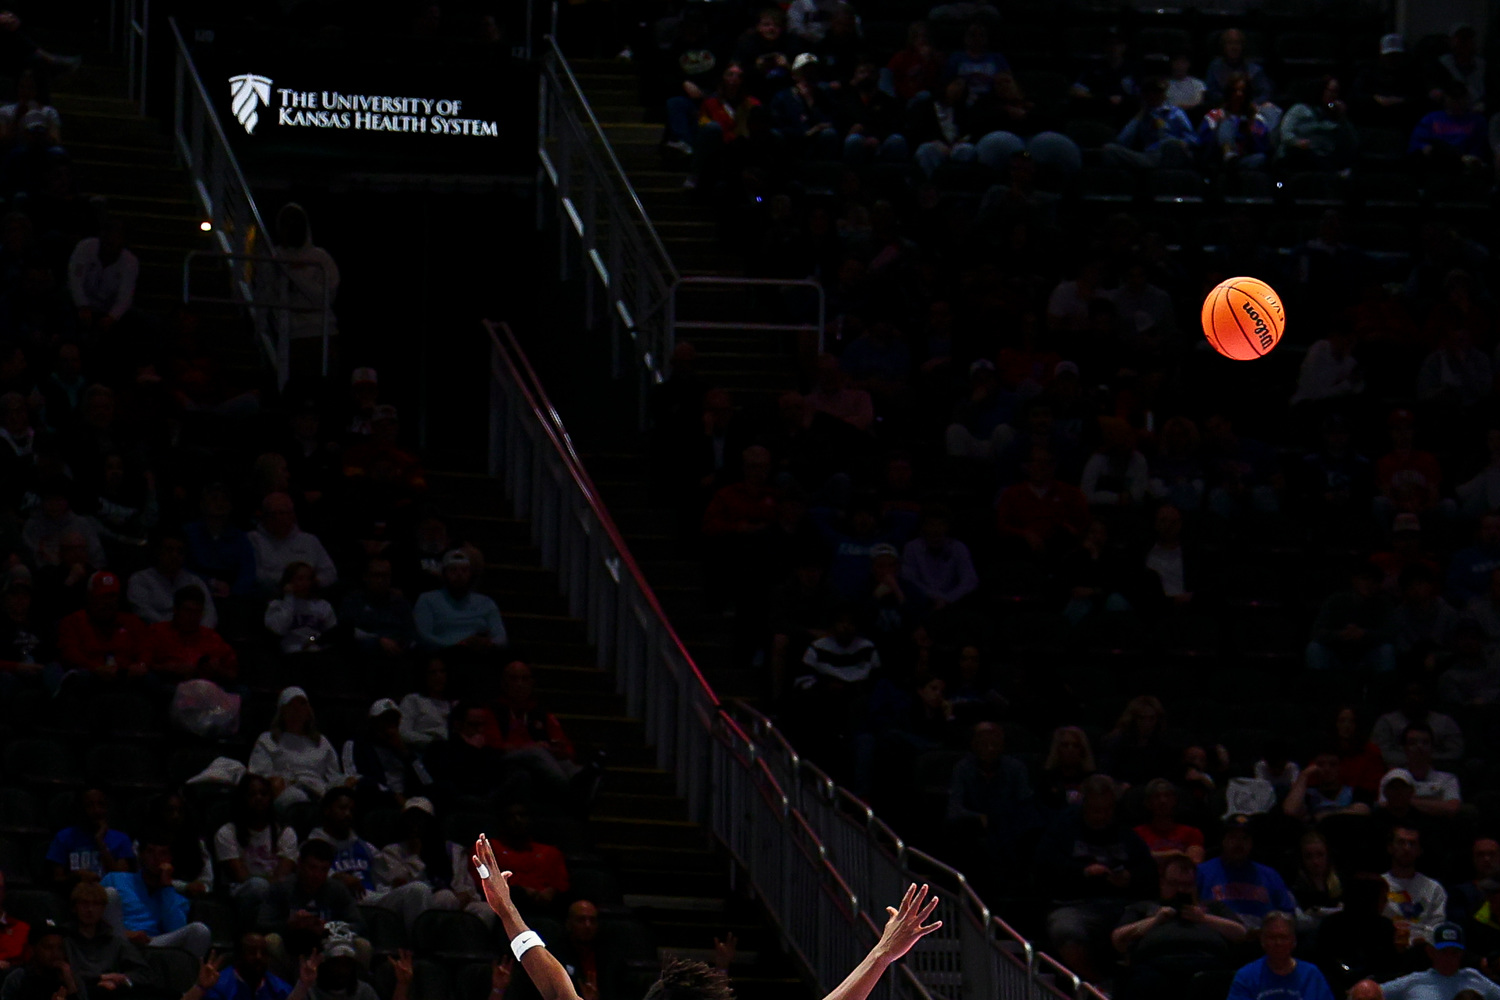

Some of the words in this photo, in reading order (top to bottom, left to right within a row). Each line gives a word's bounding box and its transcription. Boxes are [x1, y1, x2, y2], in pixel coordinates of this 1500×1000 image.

[276, 87, 318, 109] THE
[321, 90, 433, 116] UNIVERSITY
[435, 99, 463, 116] OF
[278, 106, 351, 130] KANSAS
[354, 111, 426, 134] HEALTH
[429, 115, 499, 138] SYSTEM
[1242, 301, 1274, 350] Wilson
